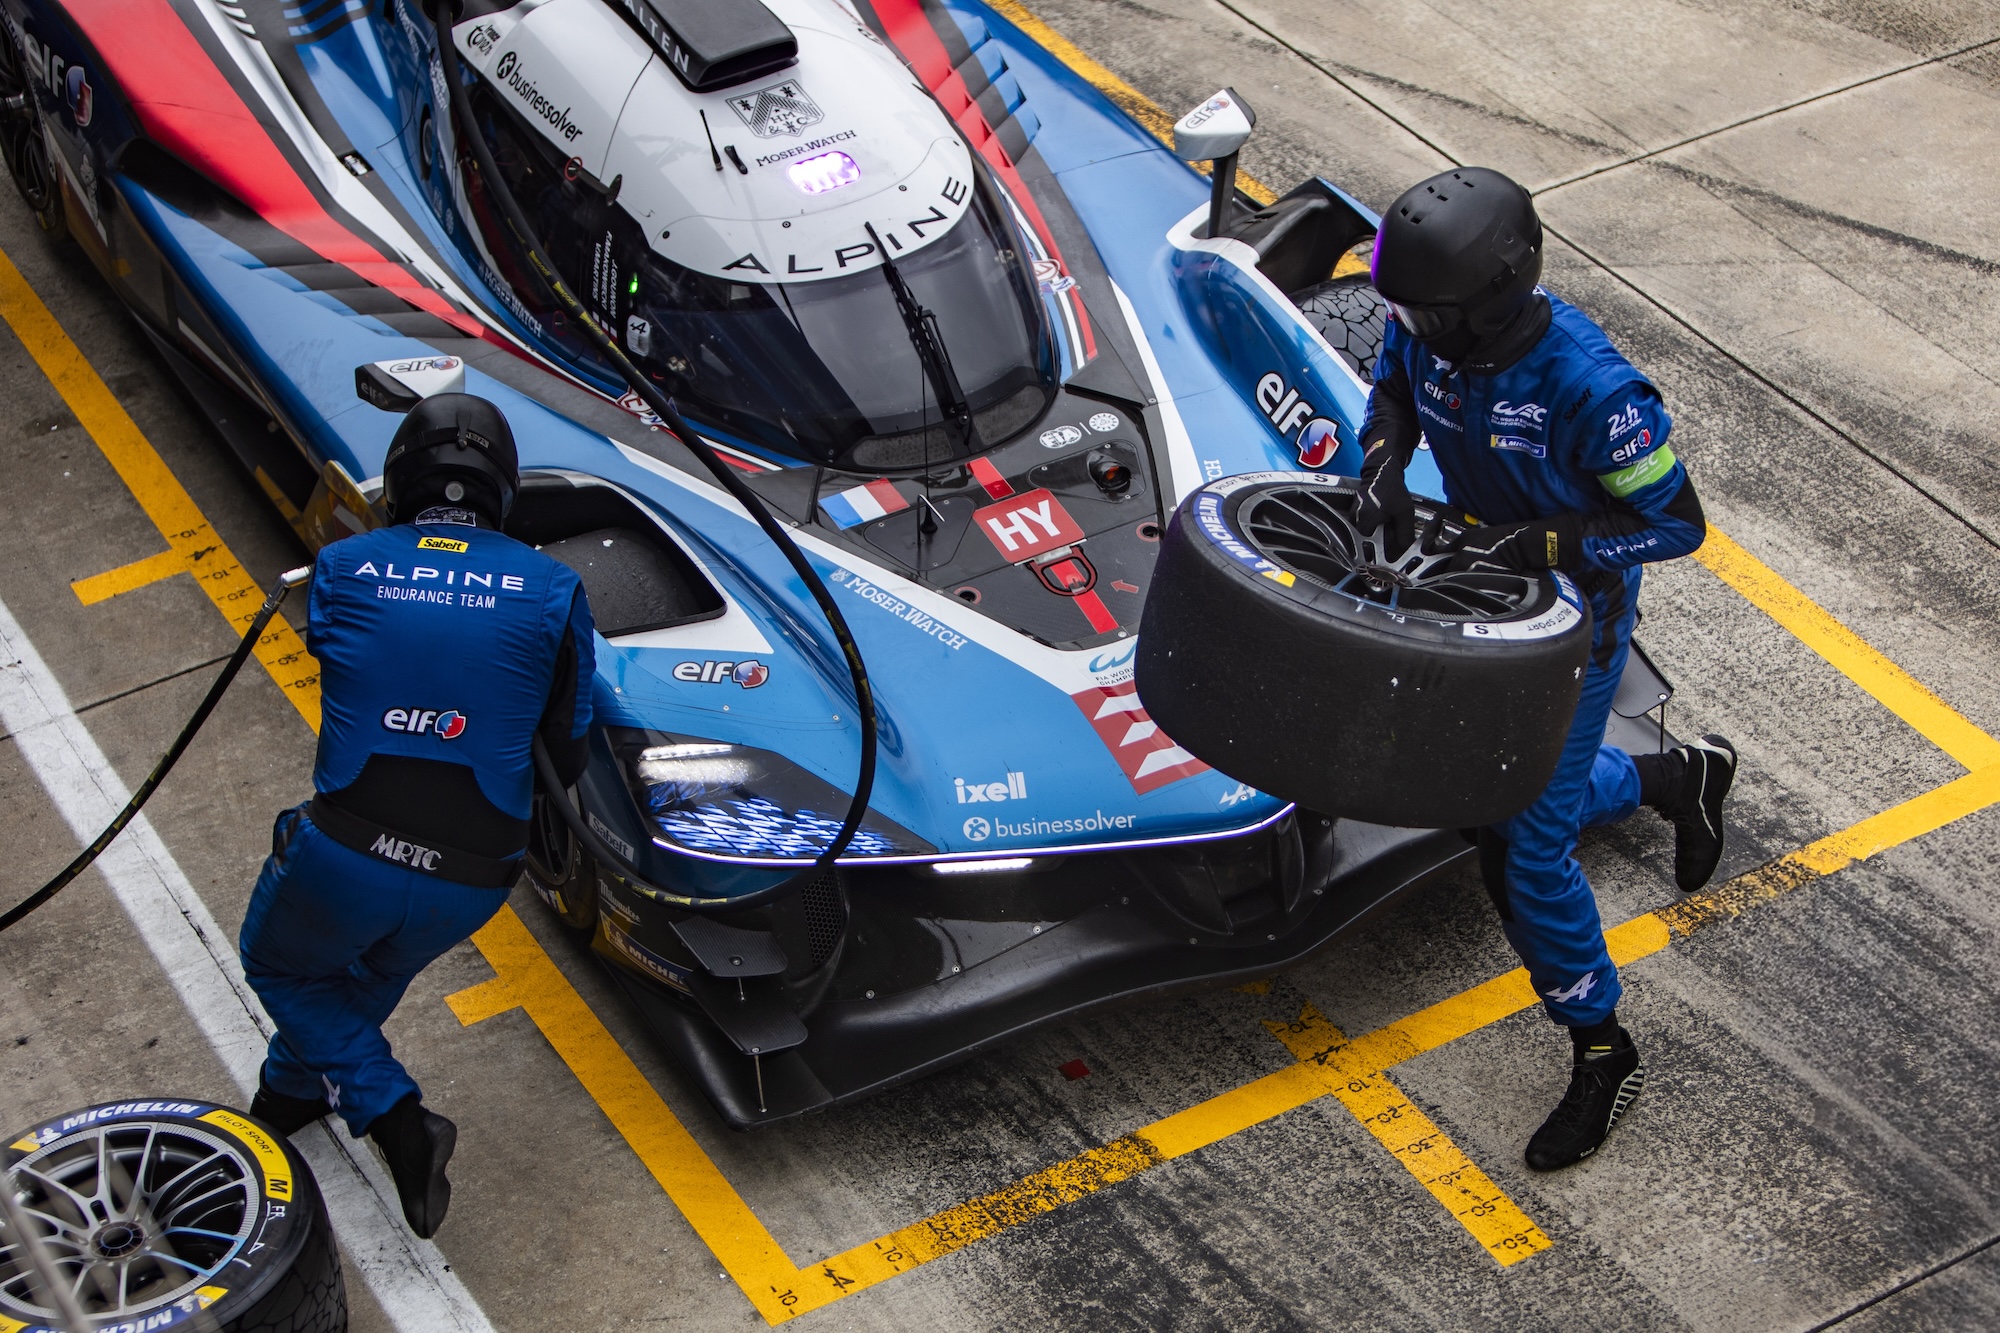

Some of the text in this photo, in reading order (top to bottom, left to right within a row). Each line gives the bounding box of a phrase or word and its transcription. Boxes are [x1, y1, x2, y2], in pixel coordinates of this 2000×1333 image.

[625, 0, 690, 73] ALTEN
[24, 33, 64, 97] elf
[508, 64, 583, 143] businessolver
[770, 111, 796, 124] HM
[755, 130, 857, 167] MOSER.WATCH
[721, 176, 967, 274] ALPINE
[390, 360, 433, 373] elf
[1424, 381, 1446, 400] elf
[1256, 371, 1314, 435] elf
[1493, 401, 1547, 422] WEC
[1612, 438, 1638, 463] elf
[1215, 478, 1238, 491] PILOT
[1314, 474, 1328, 483] S
[986, 499, 1062, 552] HY
[1199, 497, 1257, 559] MICHELIN
[423, 538, 462, 550] Sabelt
[212, 569, 230, 580] 10
[354, 561, 524, 591] ALPINE
[227, 590, 249, 601] 20
[377, 585, 496, 609] ENDURANCE TEAM
[845, 576, 968, 650] MOSER.WATCH
[1474, 624, 1489, 635] S
[673, 661, 733, 683] elf
[384, 709, 436, 733] elf
[954, 772, 1027, 804] ixell
[995, 809, 1136, 837] businessolver
[593, 817, 628, 857] Sabelt
[370, 833, 442, 871] MRTC
[629, 946, 683, 985] MICHE
[1348, 1079, 1371, 1093] 10
[62, 1102, 199, 1131] MICHELIN
[1377, 1106, 1403, 1124] 20
[216, 1114, 288, 1194] PILOT SPORT M
[1407, 1138, 1434, 1155] 30
[1471, 1200, 1497, 1217] 50
[882, 1246, 903, 1263] 10
[778, 1289, 798, 1307] 10
